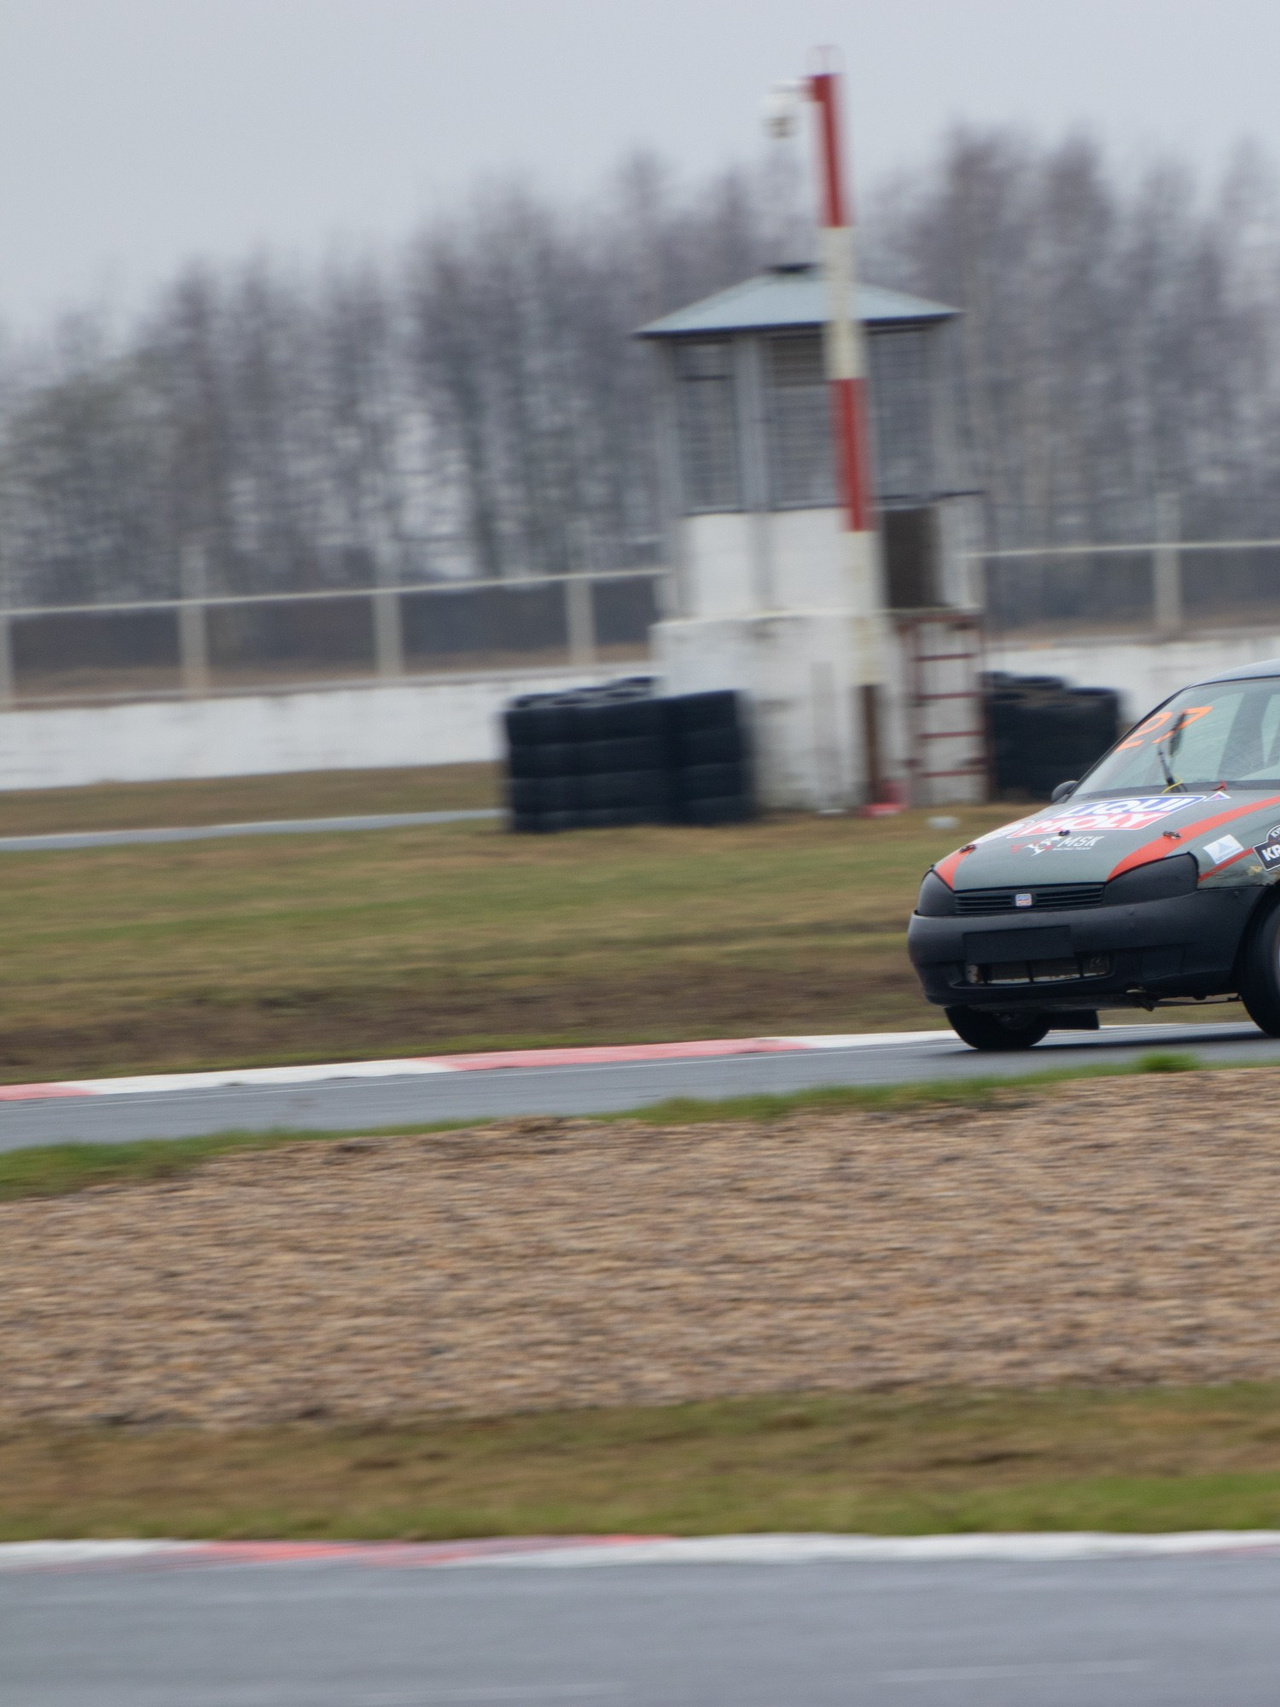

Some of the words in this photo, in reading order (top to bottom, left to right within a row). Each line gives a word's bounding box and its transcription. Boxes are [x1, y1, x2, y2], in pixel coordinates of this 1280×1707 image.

[1115, 706, 1214, 752] 27
[1055, 796, 1190, 818] LIQUI
[1020, 812, 1165, 836] MOLY
[1056, 835, 1107, 848] MSK
